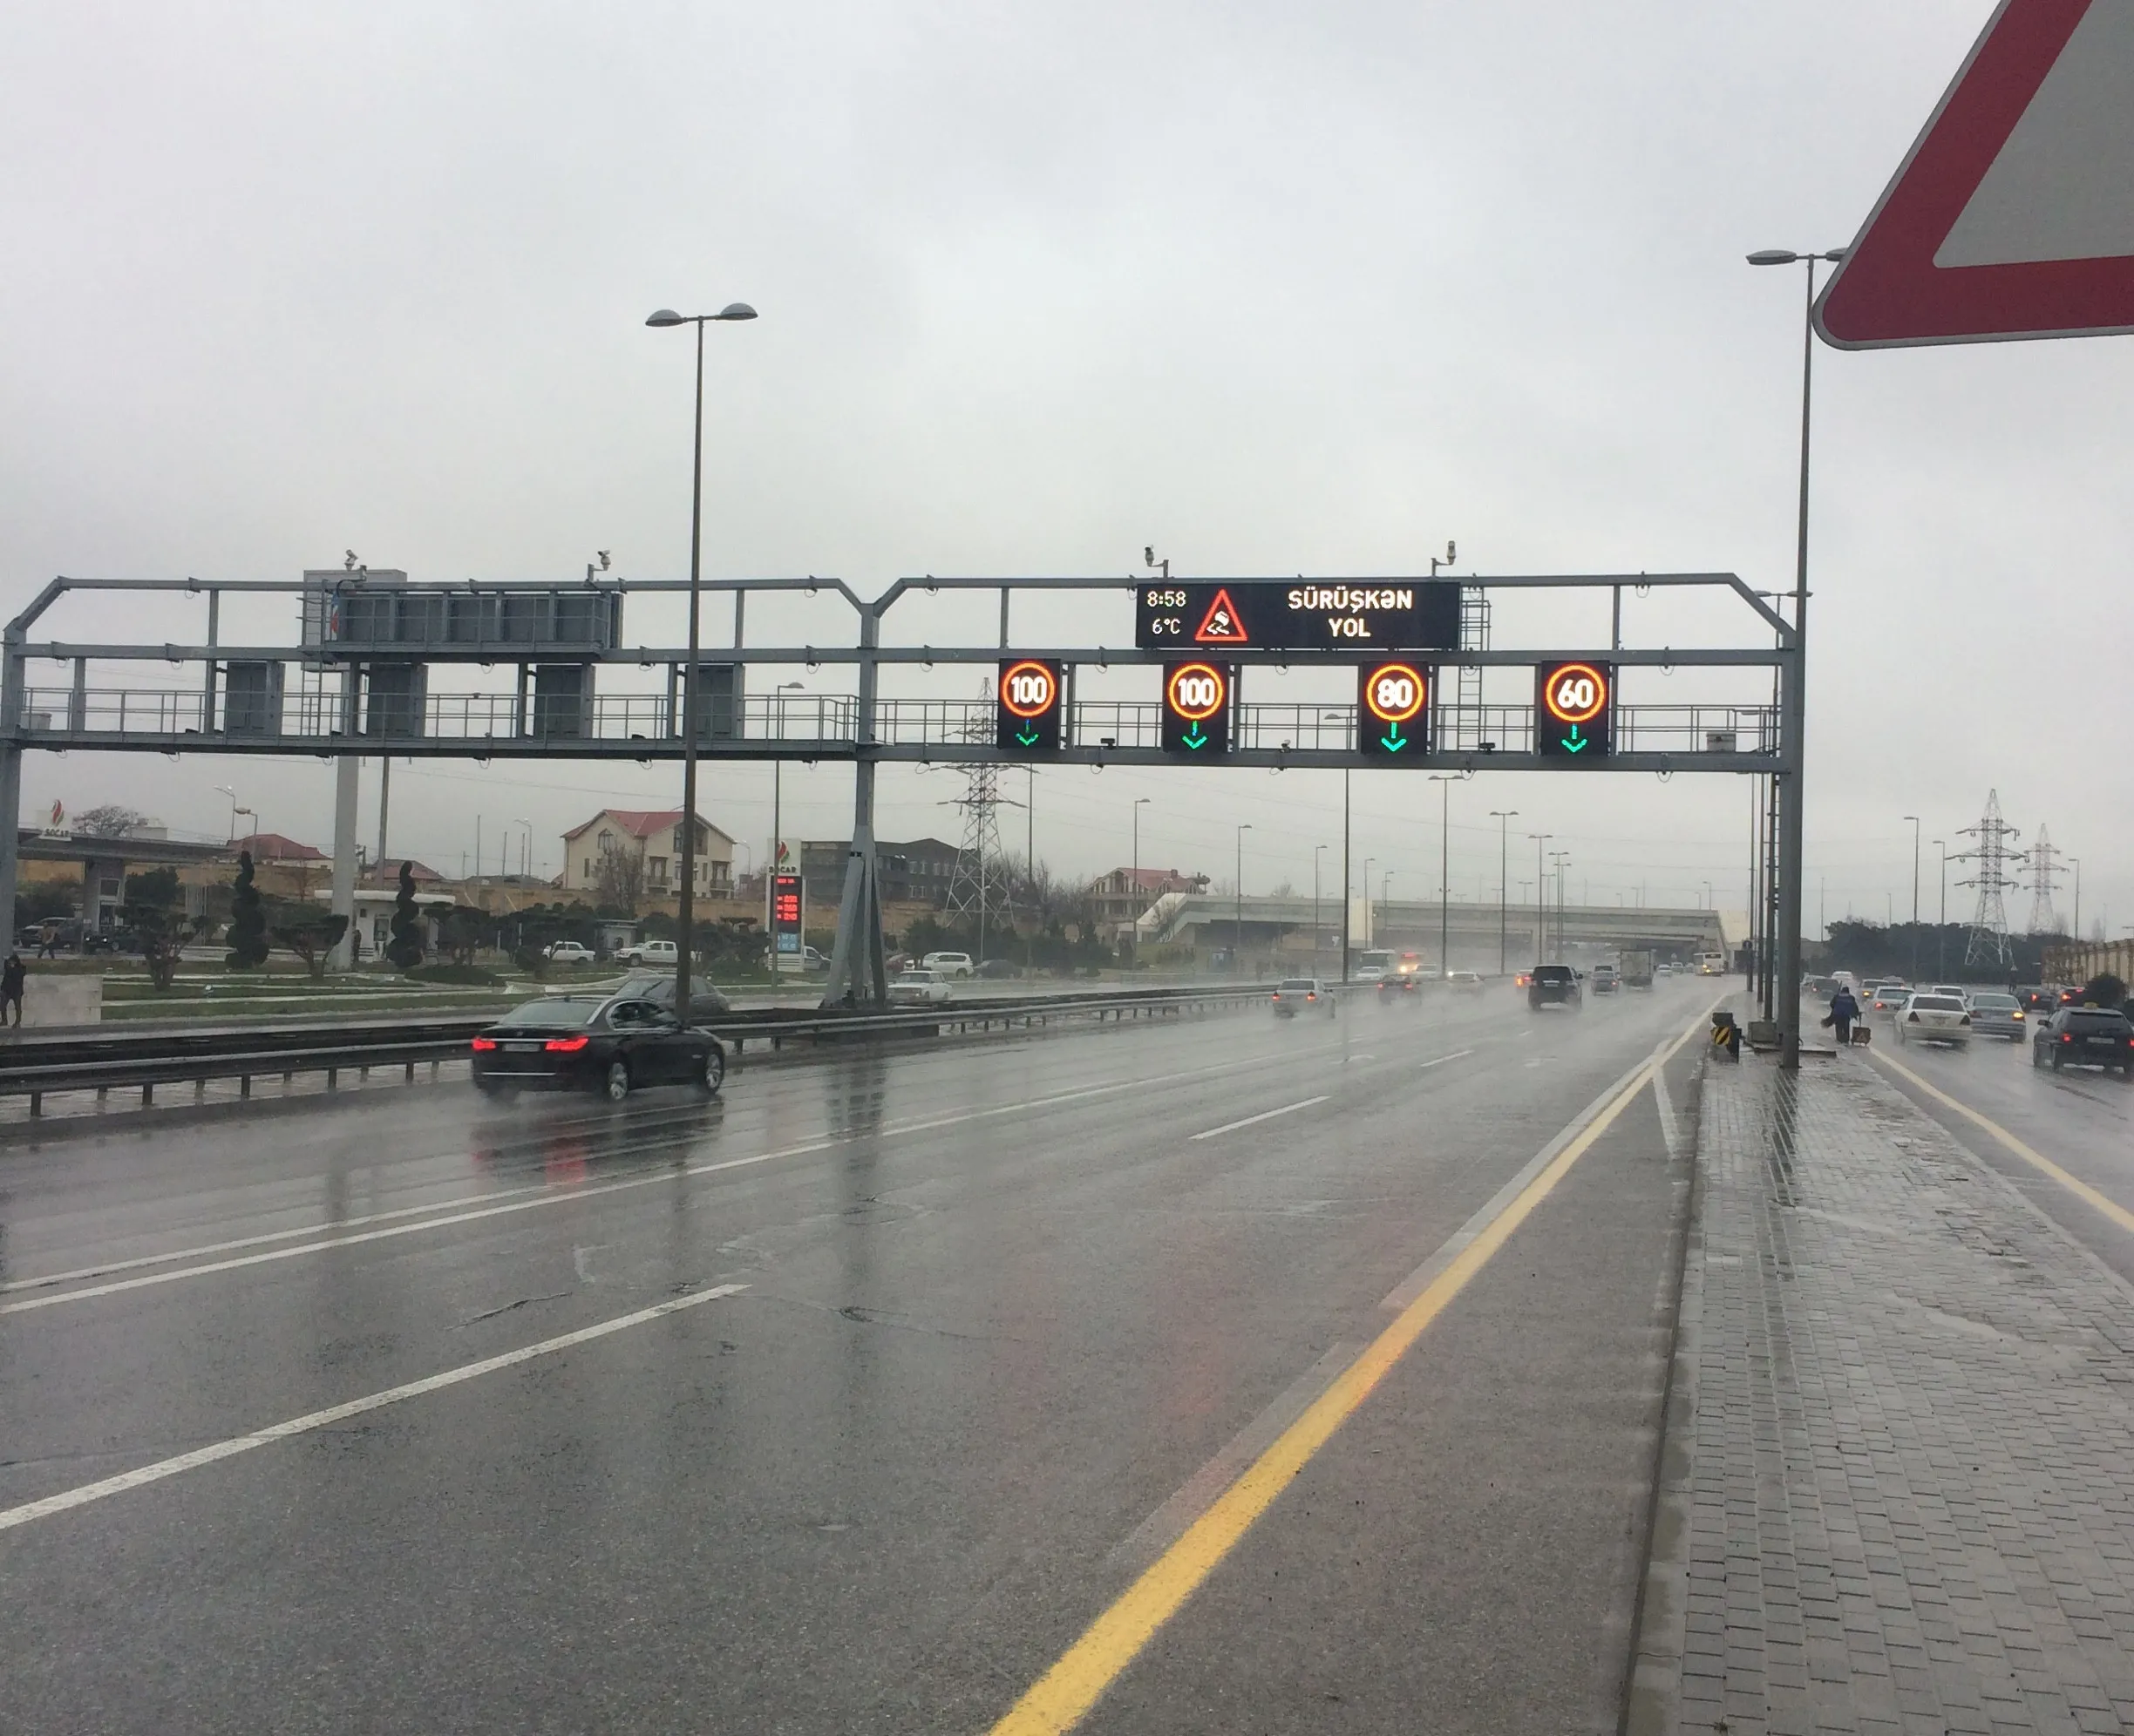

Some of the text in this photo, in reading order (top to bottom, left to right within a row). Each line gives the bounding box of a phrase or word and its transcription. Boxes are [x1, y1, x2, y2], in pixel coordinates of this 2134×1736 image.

[1147, 590, 1186, 607] 8:58
[1288, 586, 1412, 614] SÜRÜŞKƏN
[1152, 618, 1181, 634] 6°C
[1328, 618, 1371, 637] YOL
[1011, 676, 1047, 703] 100
[1178, 678, 1215, 706] 100
[1377, 679, 1413, 708] 80
[1558, 679, 1594, 708] 60
